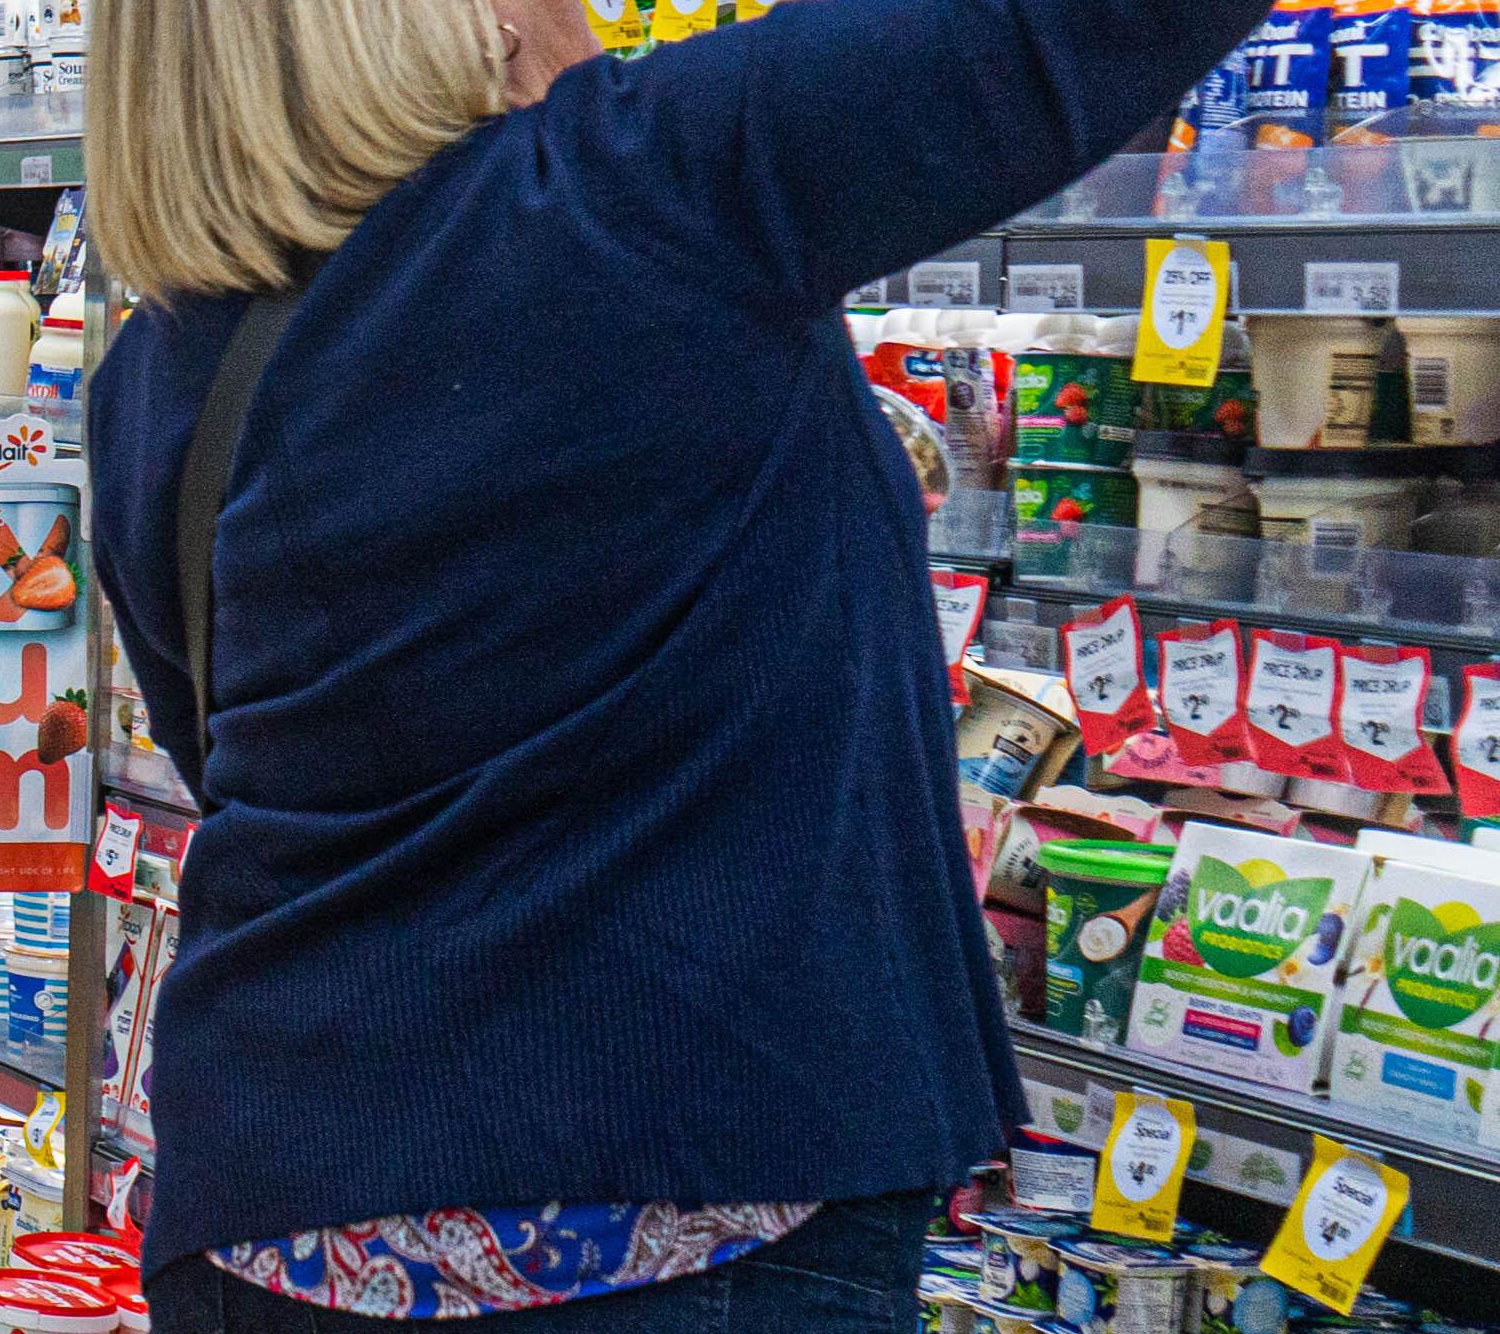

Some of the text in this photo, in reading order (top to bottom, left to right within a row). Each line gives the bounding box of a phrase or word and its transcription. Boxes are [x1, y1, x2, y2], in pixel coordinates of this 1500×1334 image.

[58, 61, 84, 75] Sou
[1191, 270, 1212, 285] OFF
[1199, 889, 1309, 940] vaalia
[1394, 933, 1500, 988] vaalia
[1133, 1122, 1172, 1139] Special
[1333, 1178, 1375, 1208] Special
